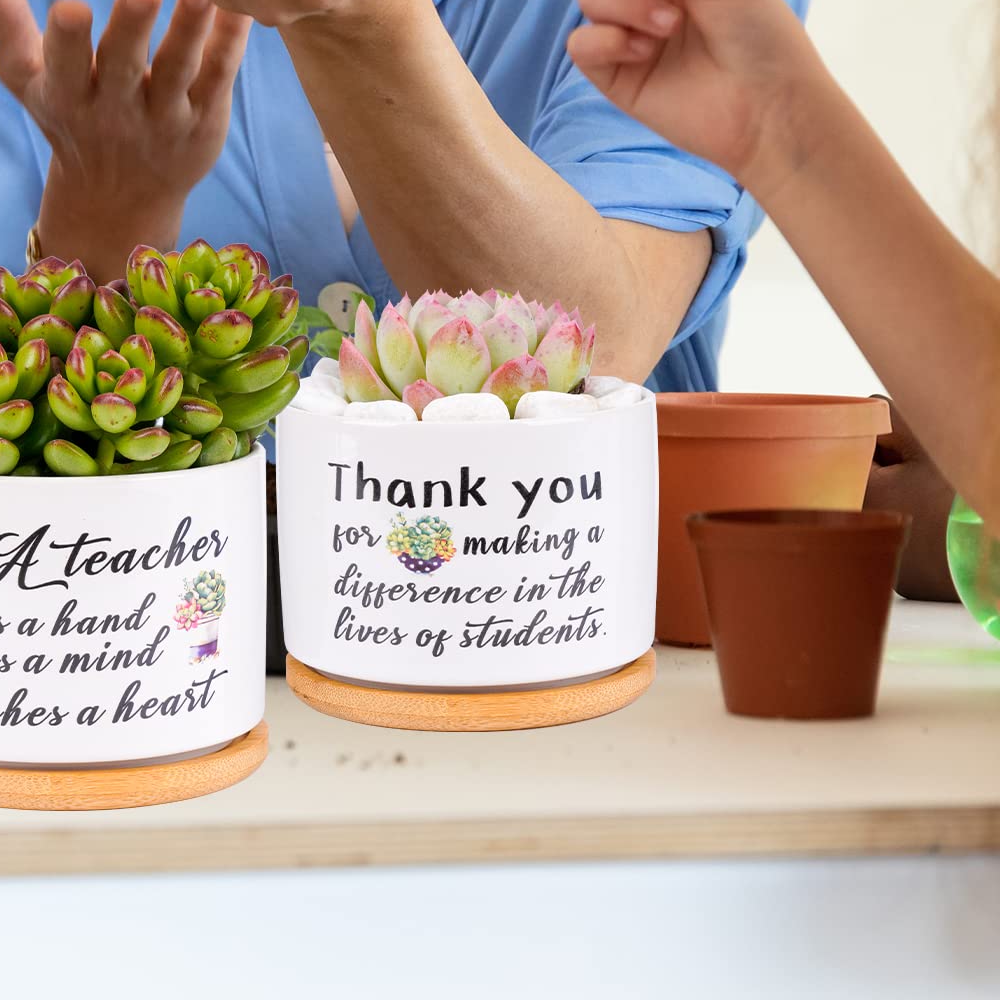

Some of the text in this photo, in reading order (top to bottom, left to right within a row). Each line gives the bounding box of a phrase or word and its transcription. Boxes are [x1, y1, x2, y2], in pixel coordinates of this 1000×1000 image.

[328, 461, 603, 519] Thank you
[48, 516, 229, 577] teacher
[332, 524, 605, 560] for making a
[334, 561, 605, 609] difference in the
[17, 613, 46, 635] a
[50, 592, 156, 635] hand
[333, 606, 608, 658] lives of students.
[22, 652, 52, 674] a
[59, 625, 171, 673] mind
[76, 703, 108, 725] a
[111, 669, 229, 724] heart
